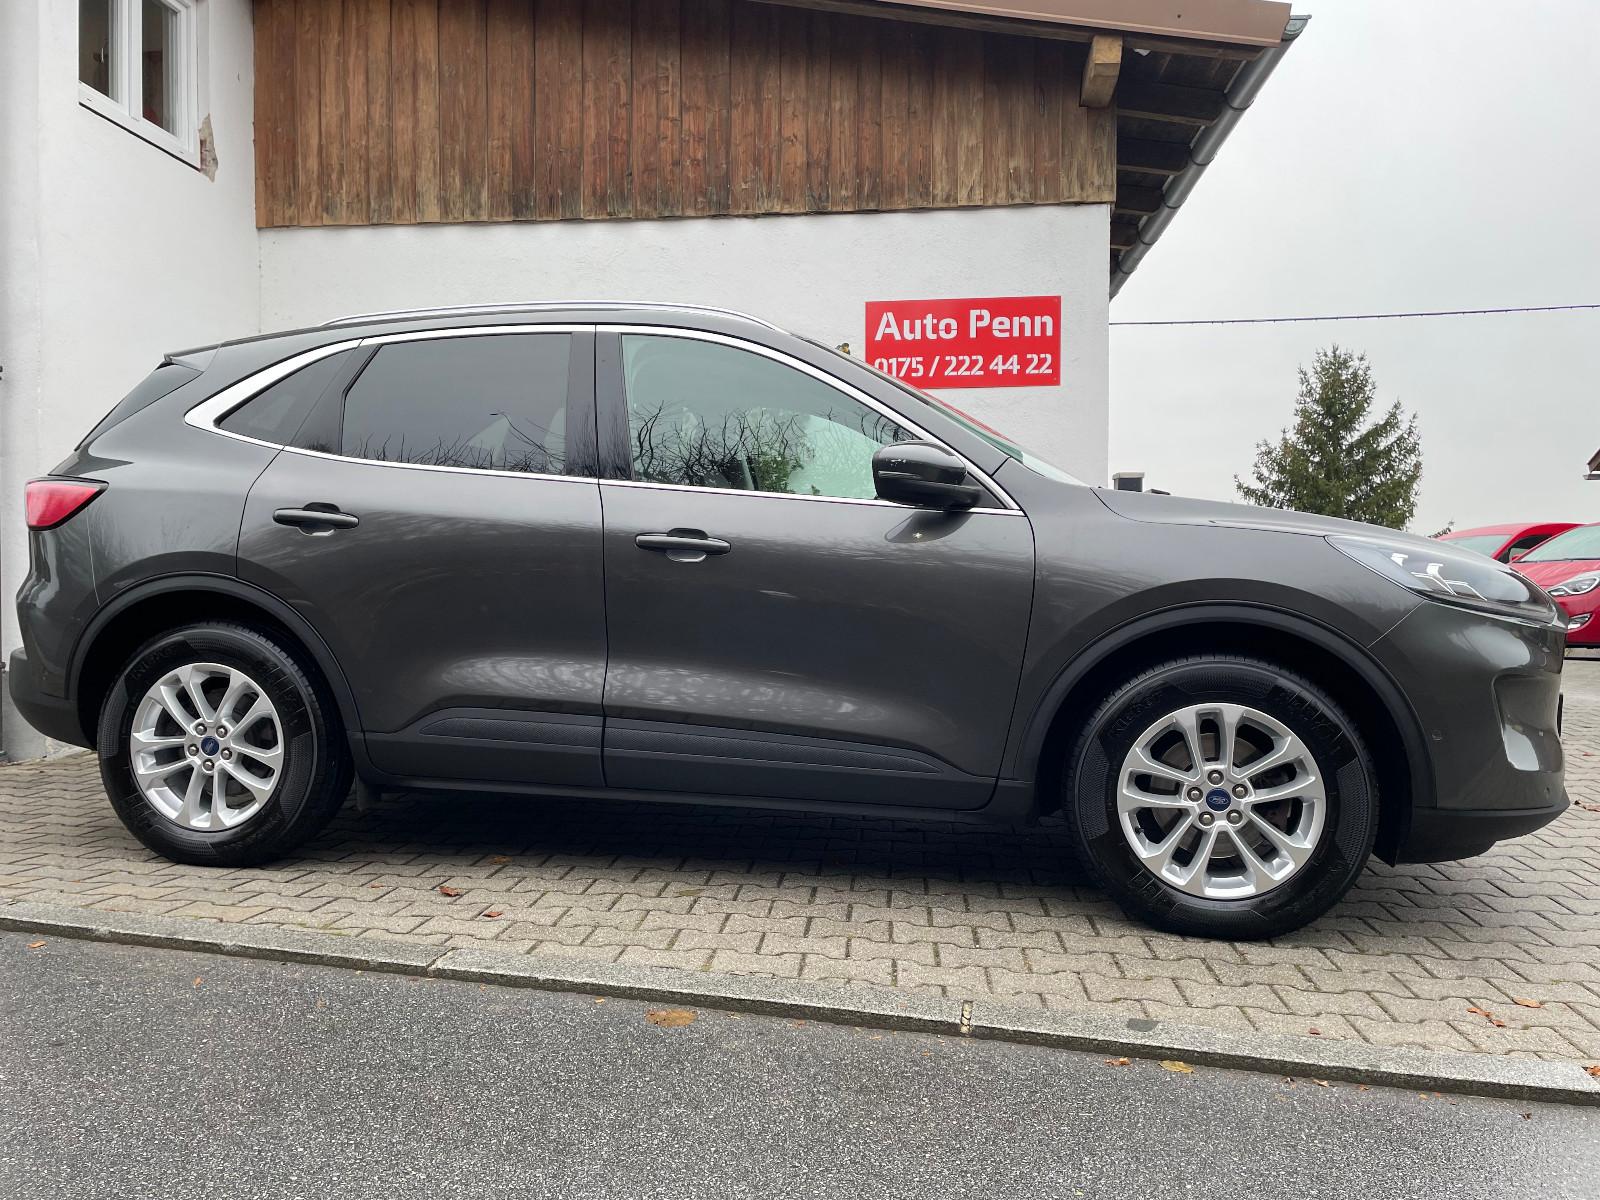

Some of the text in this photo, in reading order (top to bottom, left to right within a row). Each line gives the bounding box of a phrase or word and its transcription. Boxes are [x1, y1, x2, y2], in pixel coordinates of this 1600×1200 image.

[874, 309, 1053, 341] Auto Penn
[928, 356, 940, 377] /
[944, 355, 984, 376] 222
[989, 354, 1021, 375] 44
[1026, 353, 1053, 374] 22
